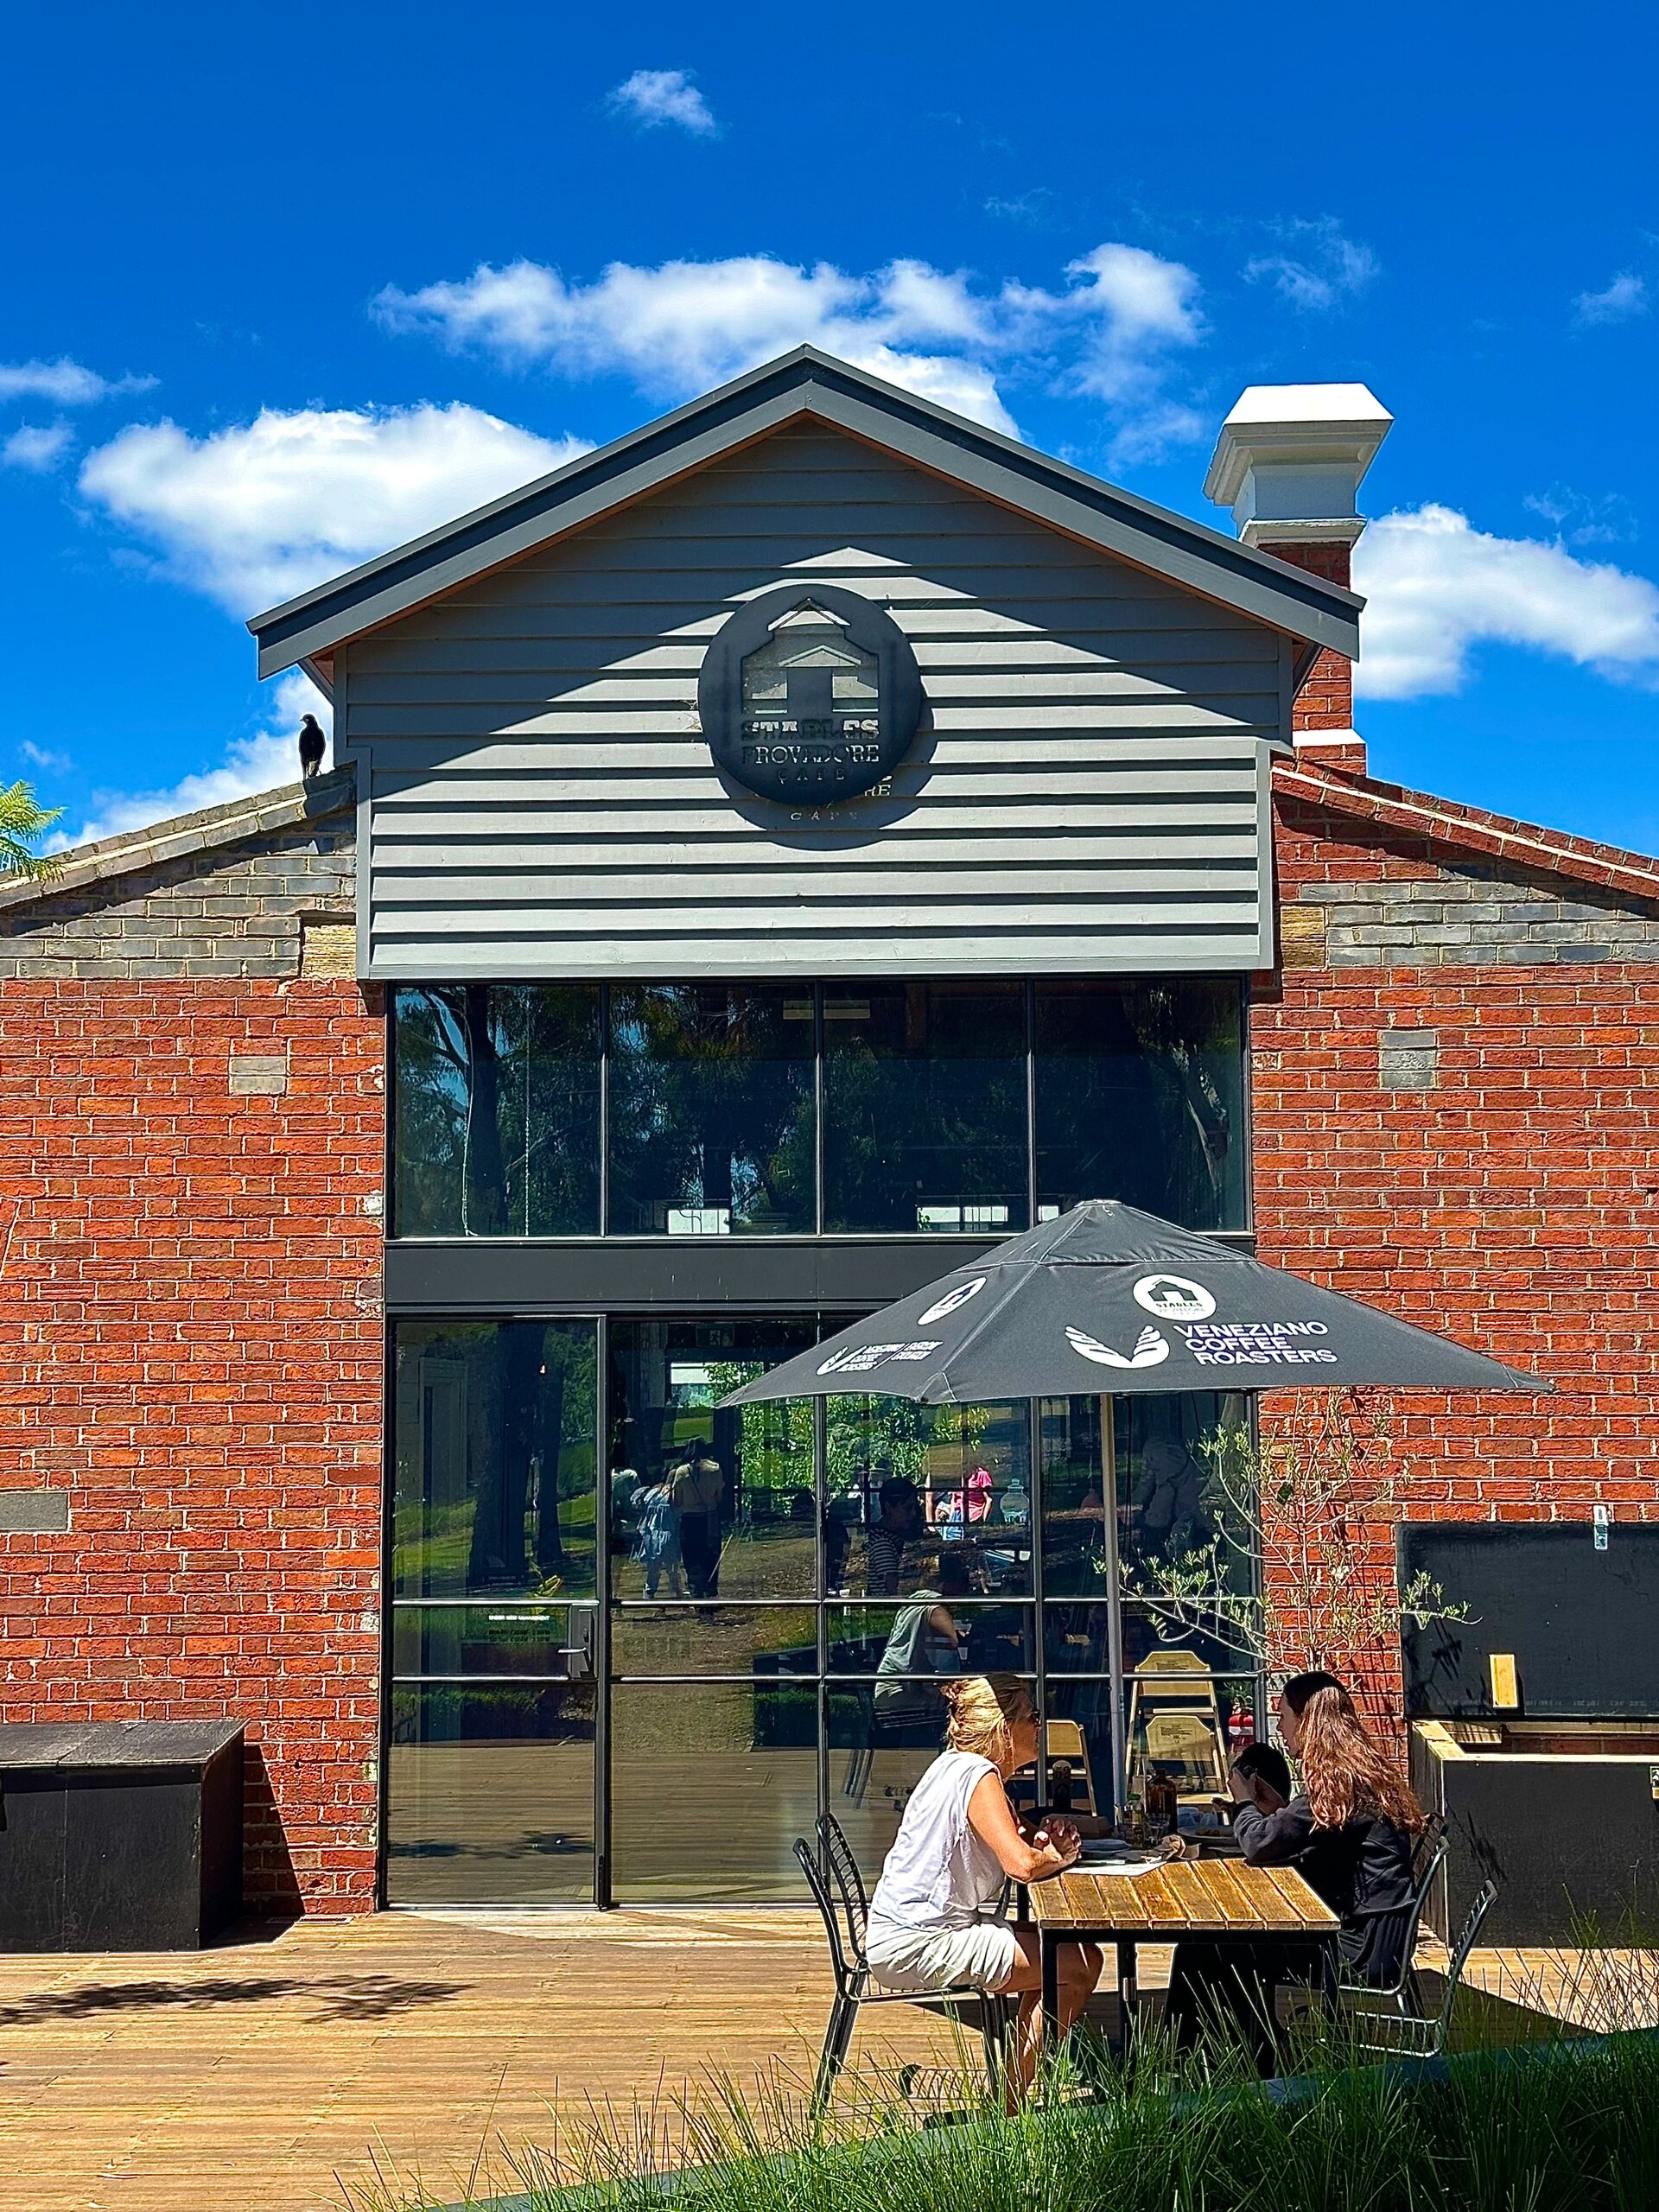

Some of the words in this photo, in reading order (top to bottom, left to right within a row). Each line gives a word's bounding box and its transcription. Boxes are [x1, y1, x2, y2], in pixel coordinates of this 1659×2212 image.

[741, 719, 880, 741] STABLES
[1173, 1321, 1329, 1338] VENEZIANO
[1185, 1337, 1292, 1351] COFFEE
[1192, 1349, 1338, 1365] ROASTERS
